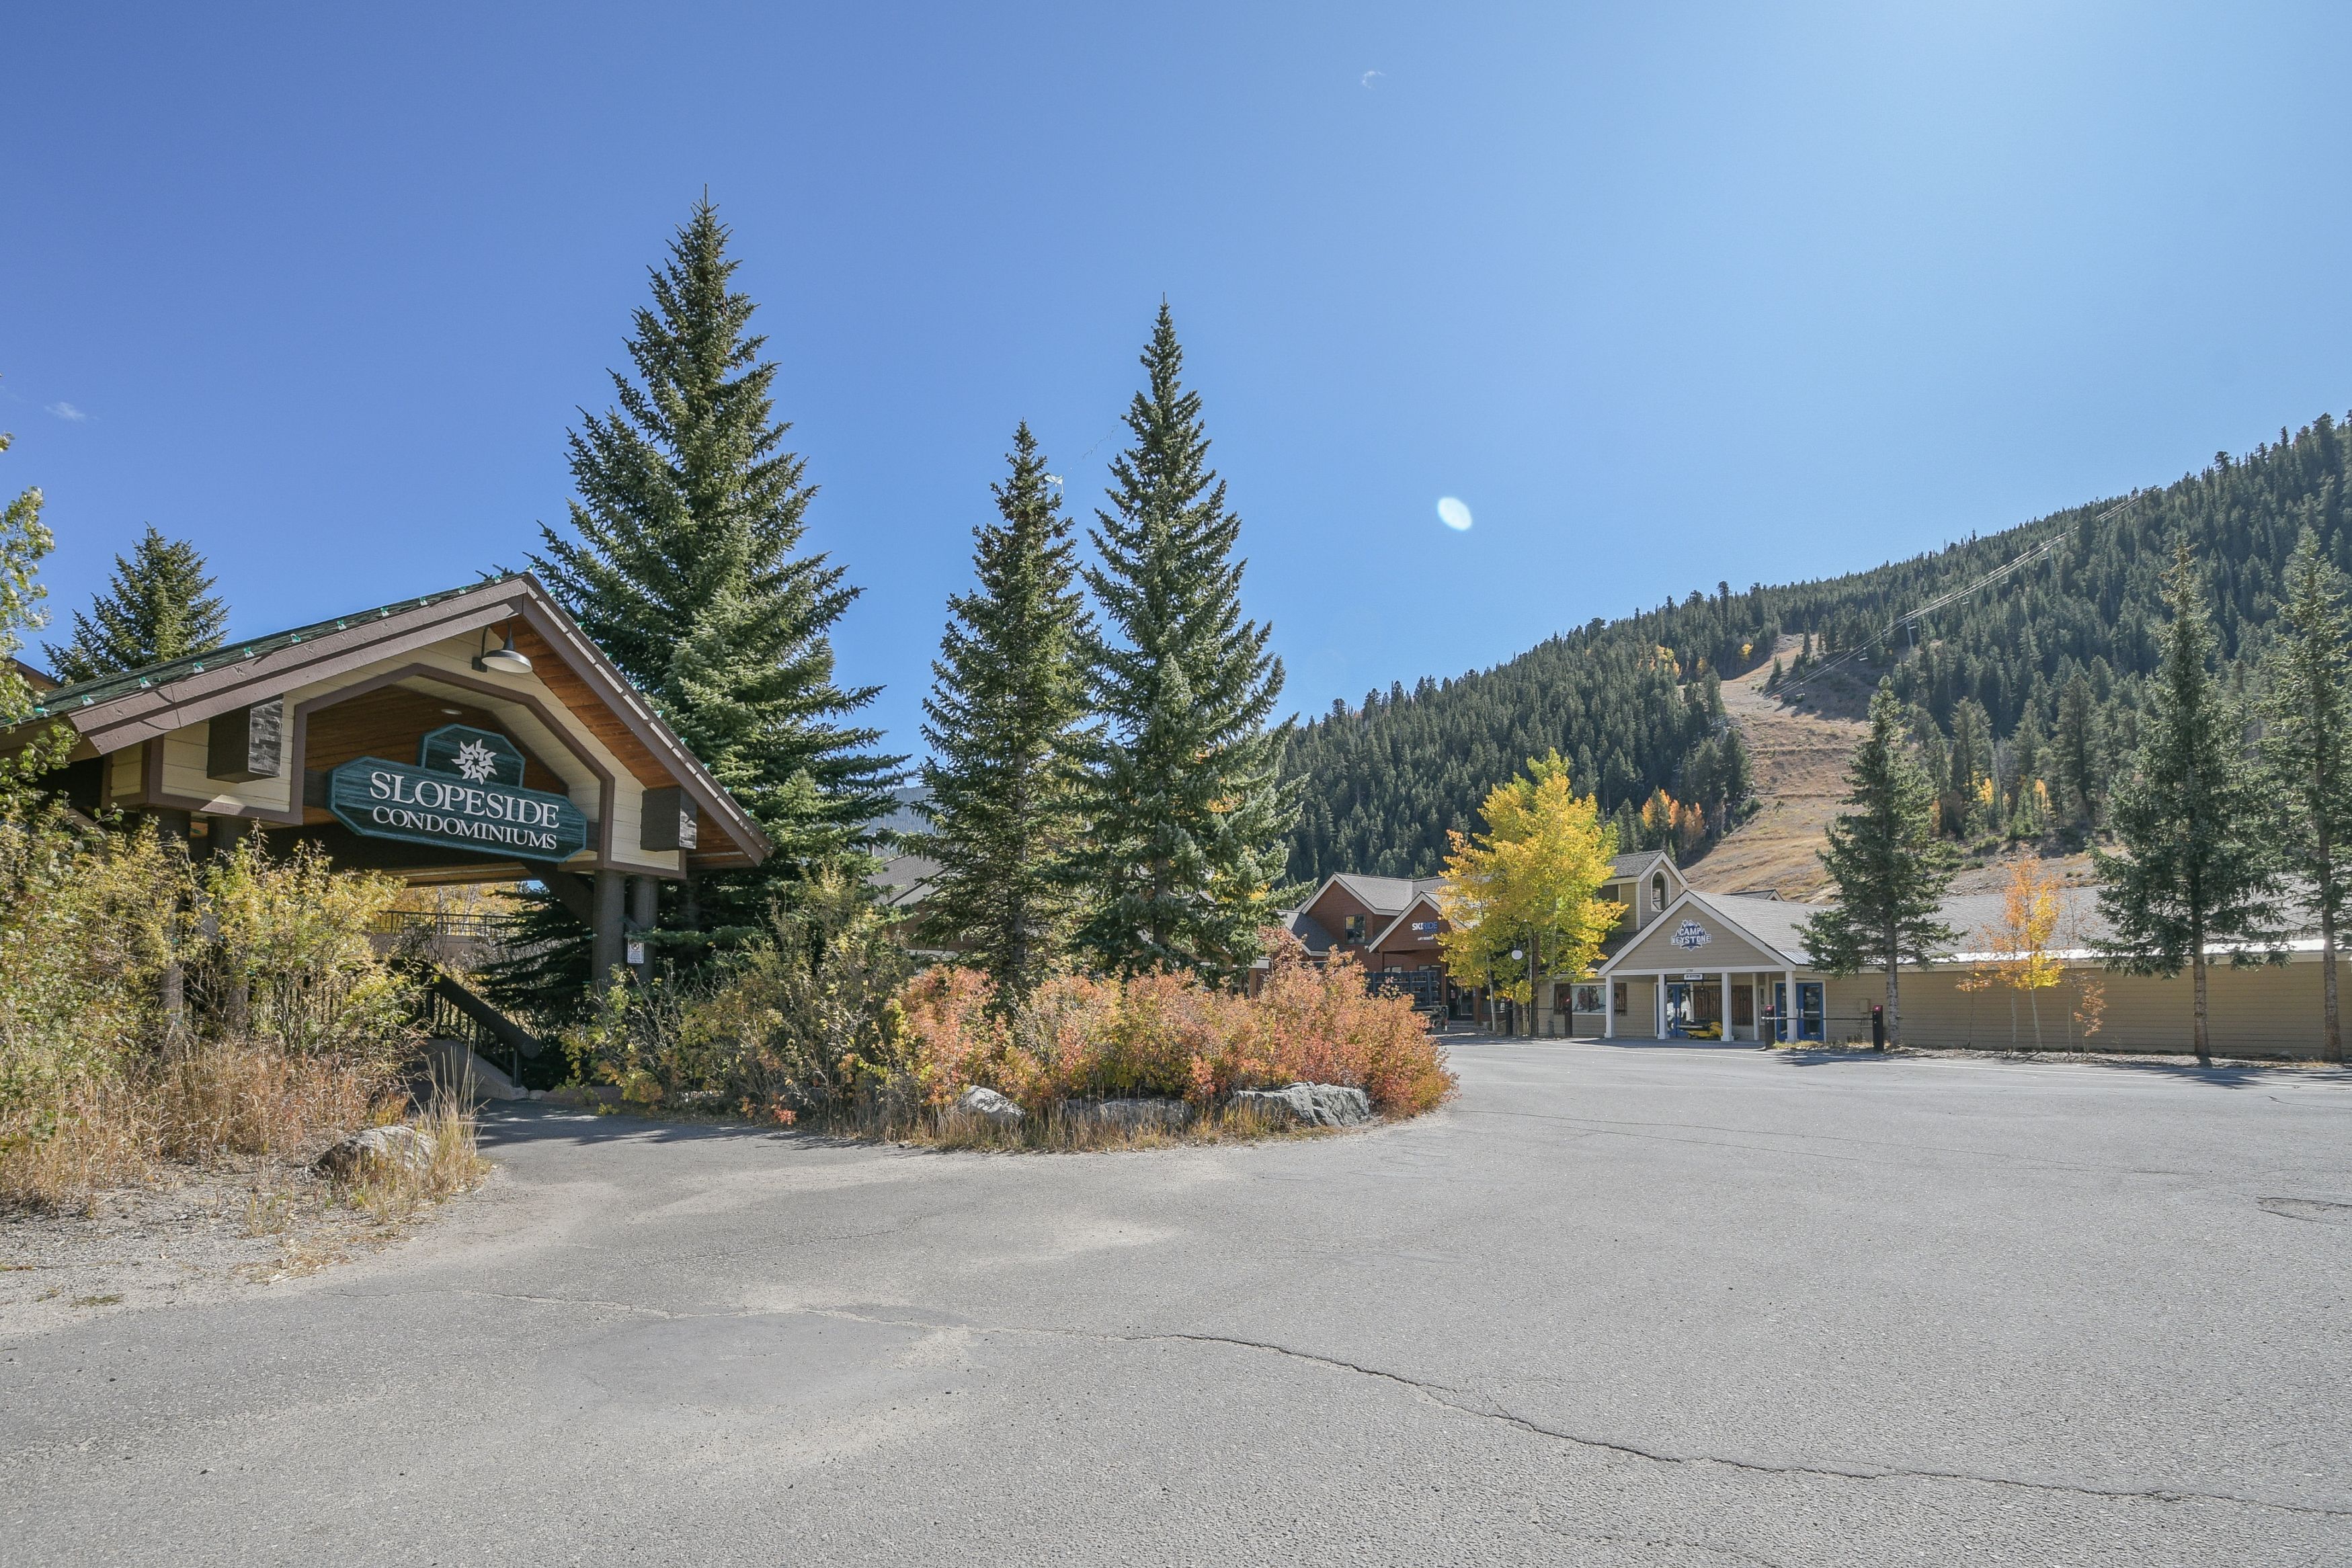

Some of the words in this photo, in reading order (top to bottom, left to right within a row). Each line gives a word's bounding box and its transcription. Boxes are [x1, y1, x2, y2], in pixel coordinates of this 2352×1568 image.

[369, 771, 560, 829] SLOPESIDE
[372, 806, 557, 850] CONDOMINIUMS
[1672, 934, 1711, 944] KEYSTONE
[1679, 927, 1701, 936] CAMP
